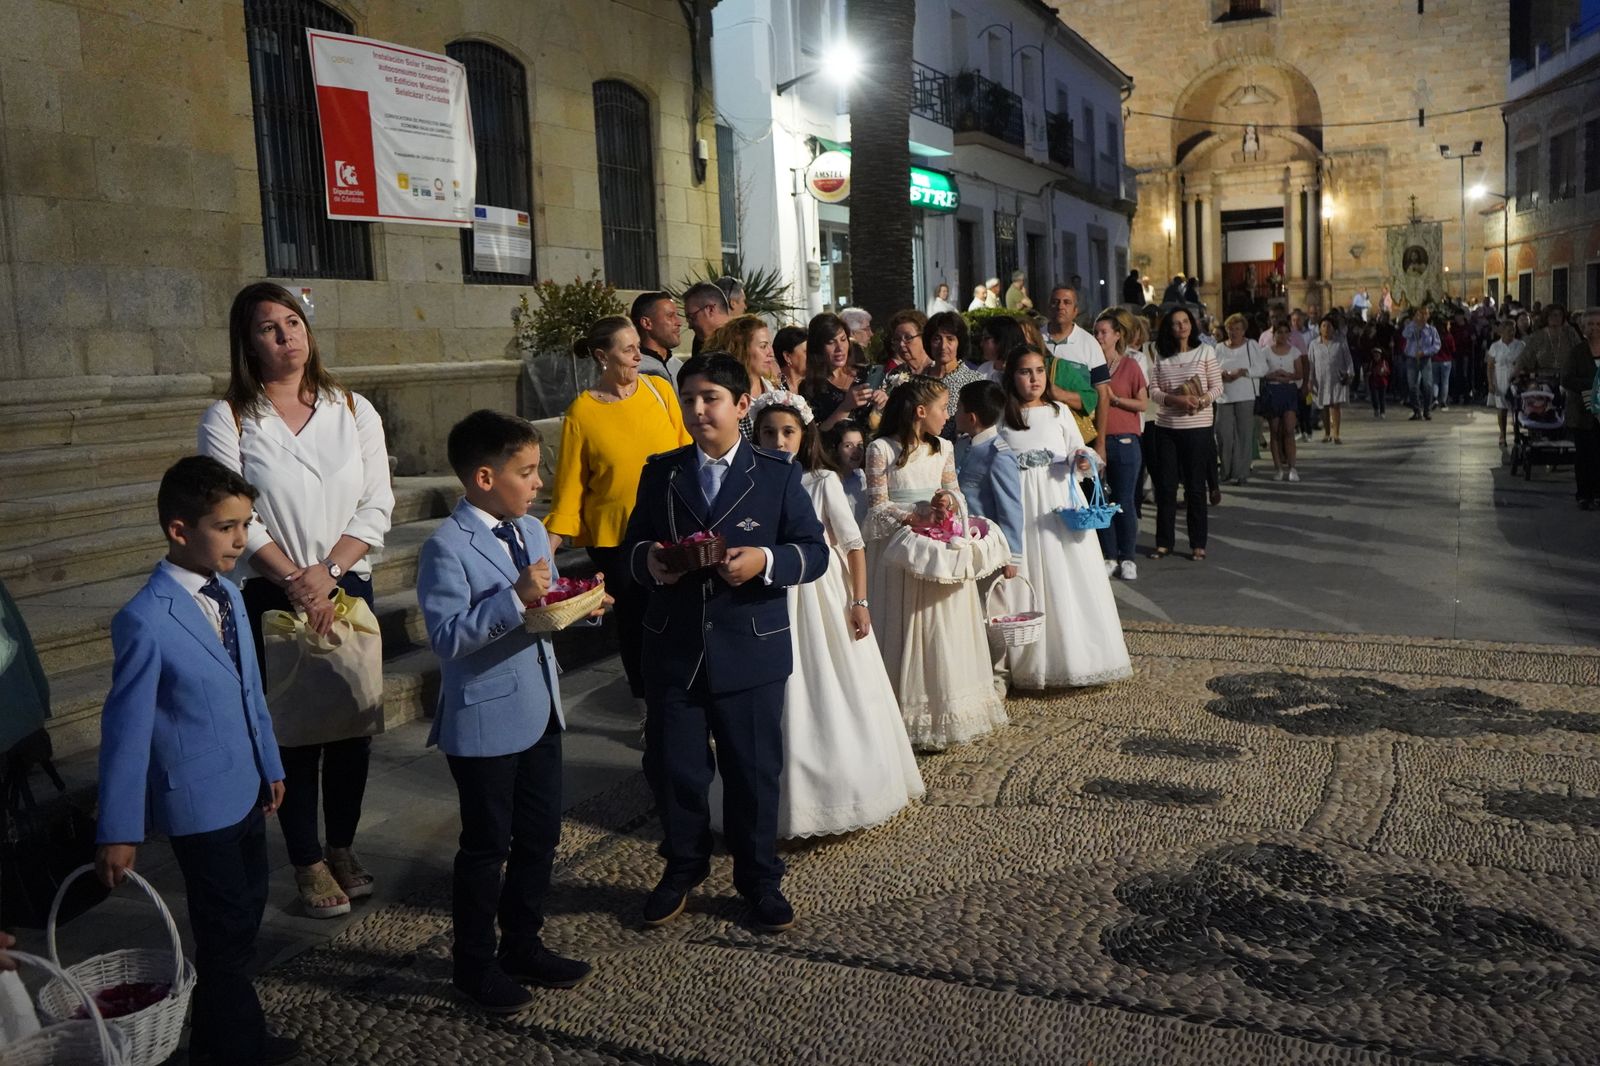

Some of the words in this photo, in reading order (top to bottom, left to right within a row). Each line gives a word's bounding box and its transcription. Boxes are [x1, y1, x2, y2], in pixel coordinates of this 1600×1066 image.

[405, 58, 420, 68] Solar
[814, 170, 844, 178] AMSTEL
[332, 187, 364, 196] Diputación
